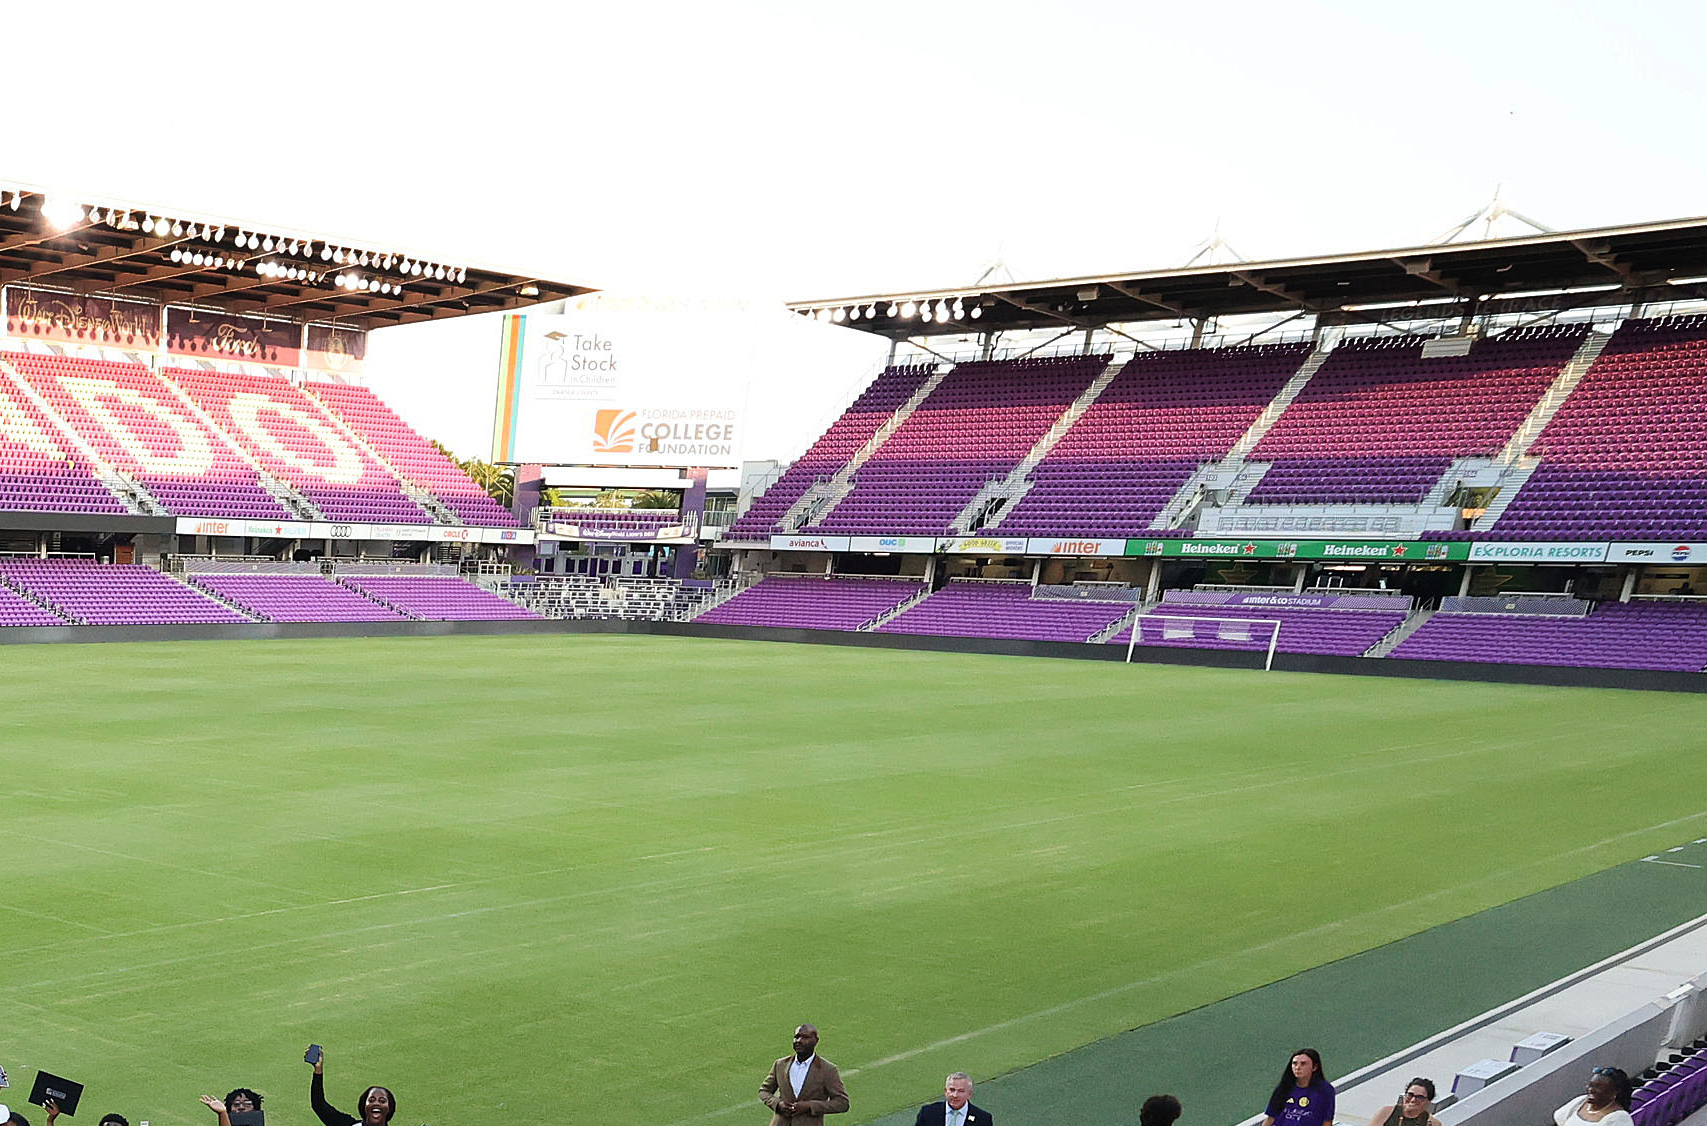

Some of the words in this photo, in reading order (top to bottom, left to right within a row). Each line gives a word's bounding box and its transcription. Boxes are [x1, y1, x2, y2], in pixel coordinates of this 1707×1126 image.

[212, 323, 261, 356] Ford
[575, 334, 613, 351] Take
[571, 354, 617, 372] Stock
[641, 423, 733, 441] COLLEGE
[201, 521, 229, 534] inter
[789, 538, 820, 548] avianca
[1063, 541, 1101, 554] inter
[1181, 542, 1240, 555] Heineken
[1323, 544, 1389, 557] Heineken
[1474, 544, 1544, 559] EXPLORIA
[1548, 546, 1603, 558] RESORTS
